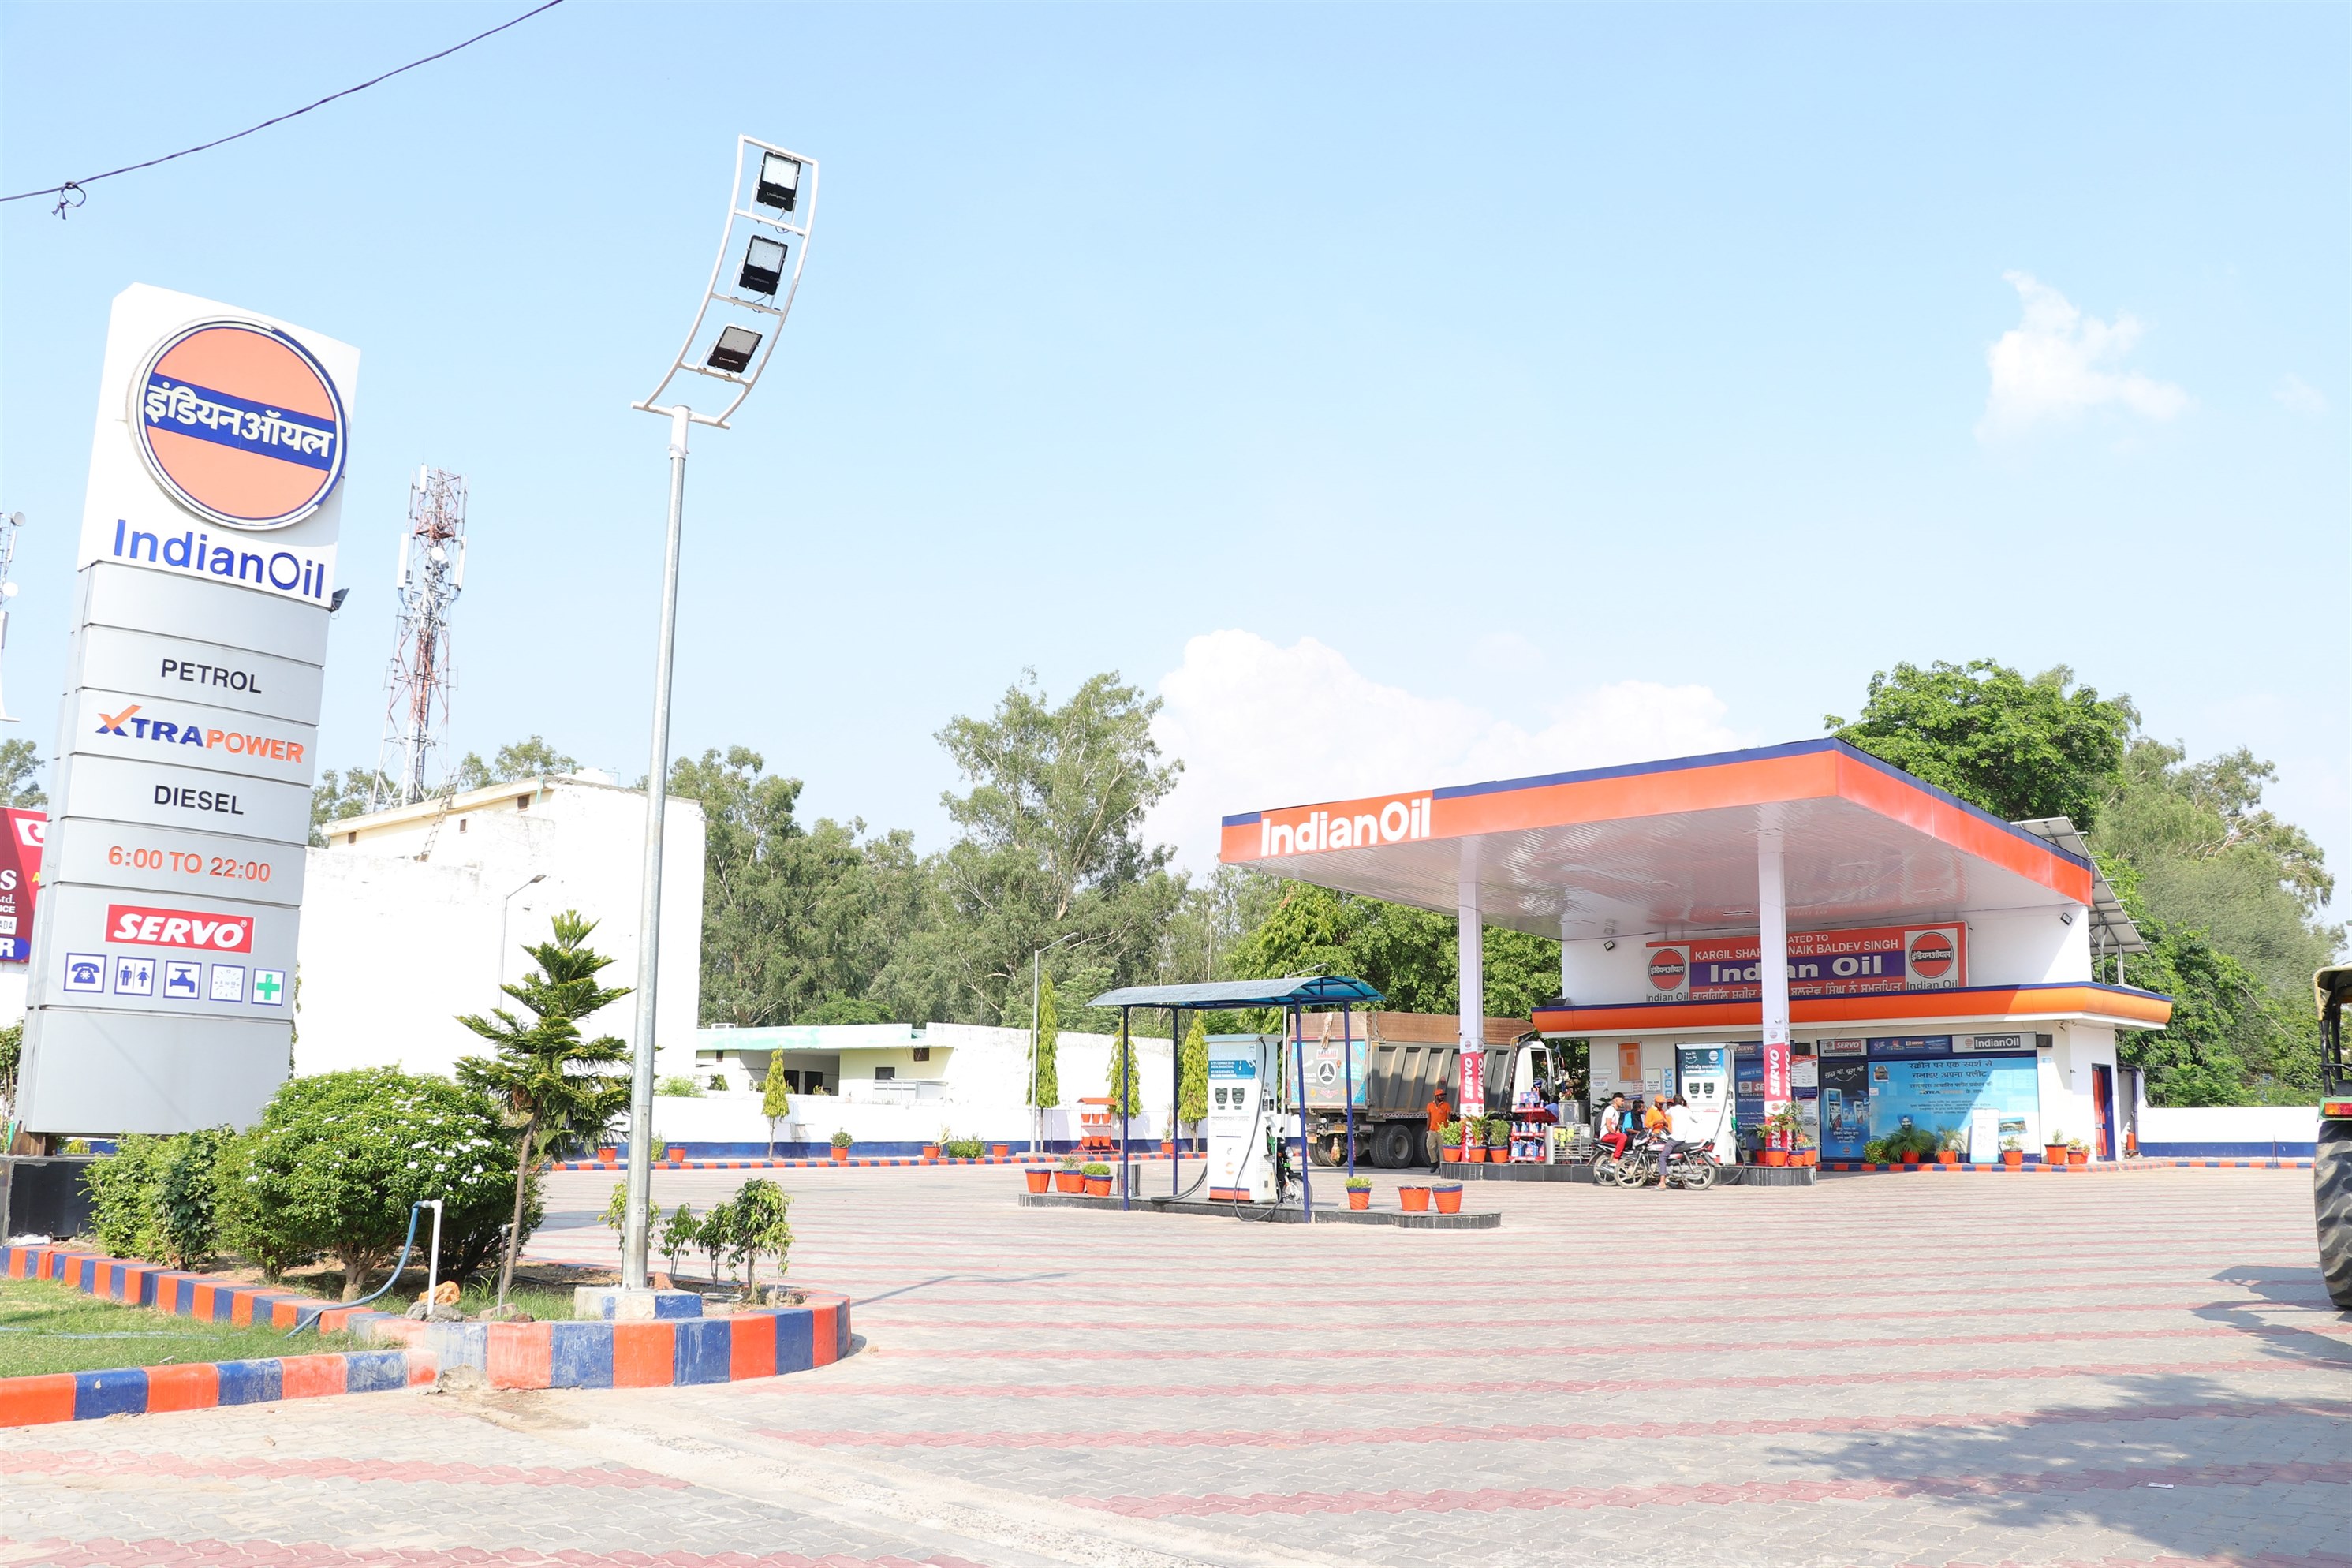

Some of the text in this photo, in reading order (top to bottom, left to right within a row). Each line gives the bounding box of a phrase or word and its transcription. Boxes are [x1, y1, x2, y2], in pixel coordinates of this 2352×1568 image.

[145, 381, 334, 457] इंडियनऑयल
[114, 519, 325, 599] IndianOil
[161, 658, 262, 694] PETROL
[95, 704, 304, 763] XTRAPOWER
[154, 785, 245, 816] DIESEL
[1260, 797, 1431, 857] IndianOil
[107, 846, 271, 883] 6:00 TO 22:00
[1695, 950, 1733, 961] KARGIL
[1788, 944, 1813, 955] NAIK
[1816, 942, 1861, 954] BALDEV
[1864, 939, 1898, 950] SINGH
[1832, 955, 1882, 976] Oil
[1911, 950, 1951, 961] इंडियनऑयल
[1646, 991, 1689, 1002] Indian Oil
[1906, 979, 1958, 991] Indian Oil
[1975, 1037, 2019, 1047] IndianOil
[1465, 1057, 1473, 1100] SERVO
[1770, 1049, 1780, 1097] SERVO
